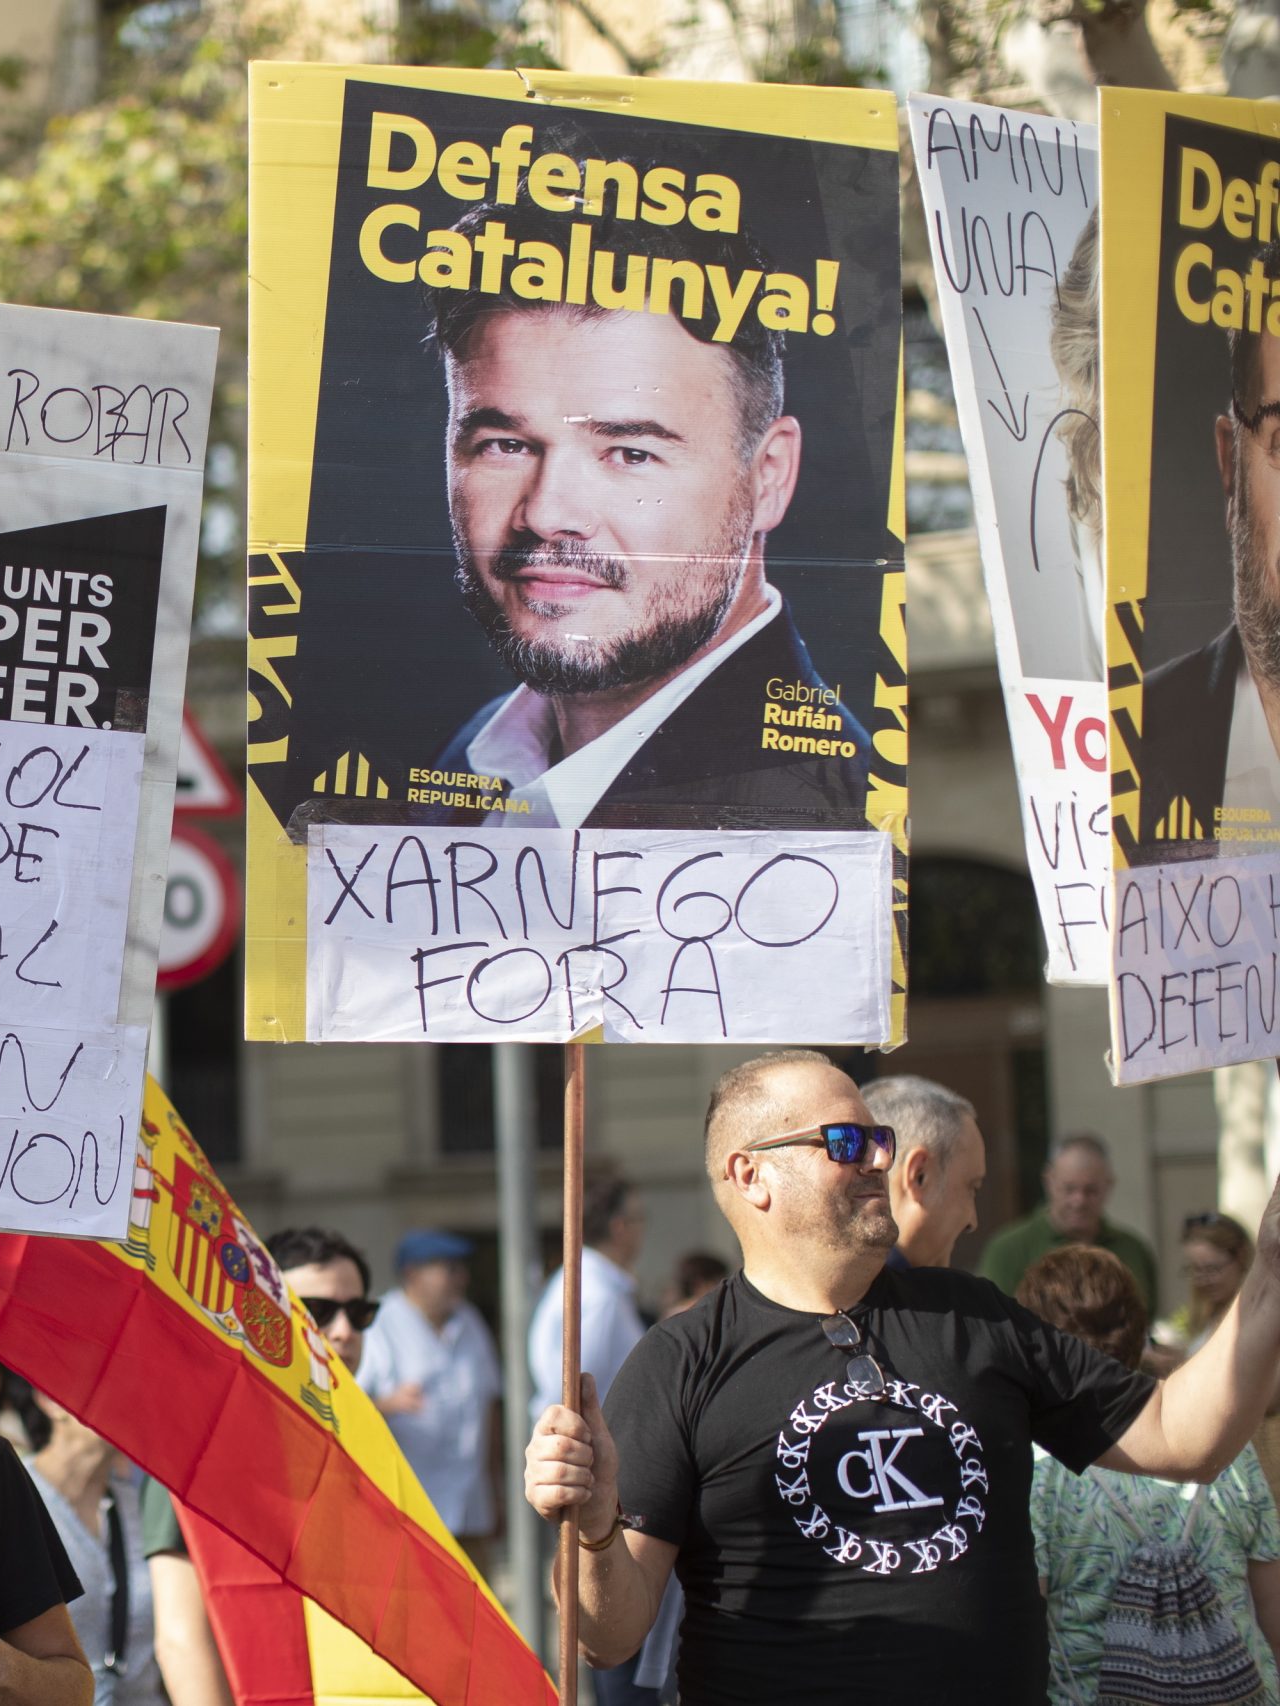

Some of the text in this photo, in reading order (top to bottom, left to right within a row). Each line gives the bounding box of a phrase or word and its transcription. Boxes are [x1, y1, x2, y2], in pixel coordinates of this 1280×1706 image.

[366, 111, 741, 235] Defensa
[1179, 147, 1280, 243] Def
[358, 204, 840, 343] Catalunya!
[935, 206, 1062, 311] UNA
[5, 368, 193, 466] ROBAR
[764, 703, 841, 731] Rufián
[766, 678, 840, 706] Gabriel
[409, 767, 503, 792] ESQUERRA
[762, 728, 856, 758] Romero
[407, 788, 531, 814] REPUBLICANA
[324, 830, 839, 948] XARNEGO
[1120, 869, 1242, 957] AIXO
[410, 936, 728, 1037] FORA
